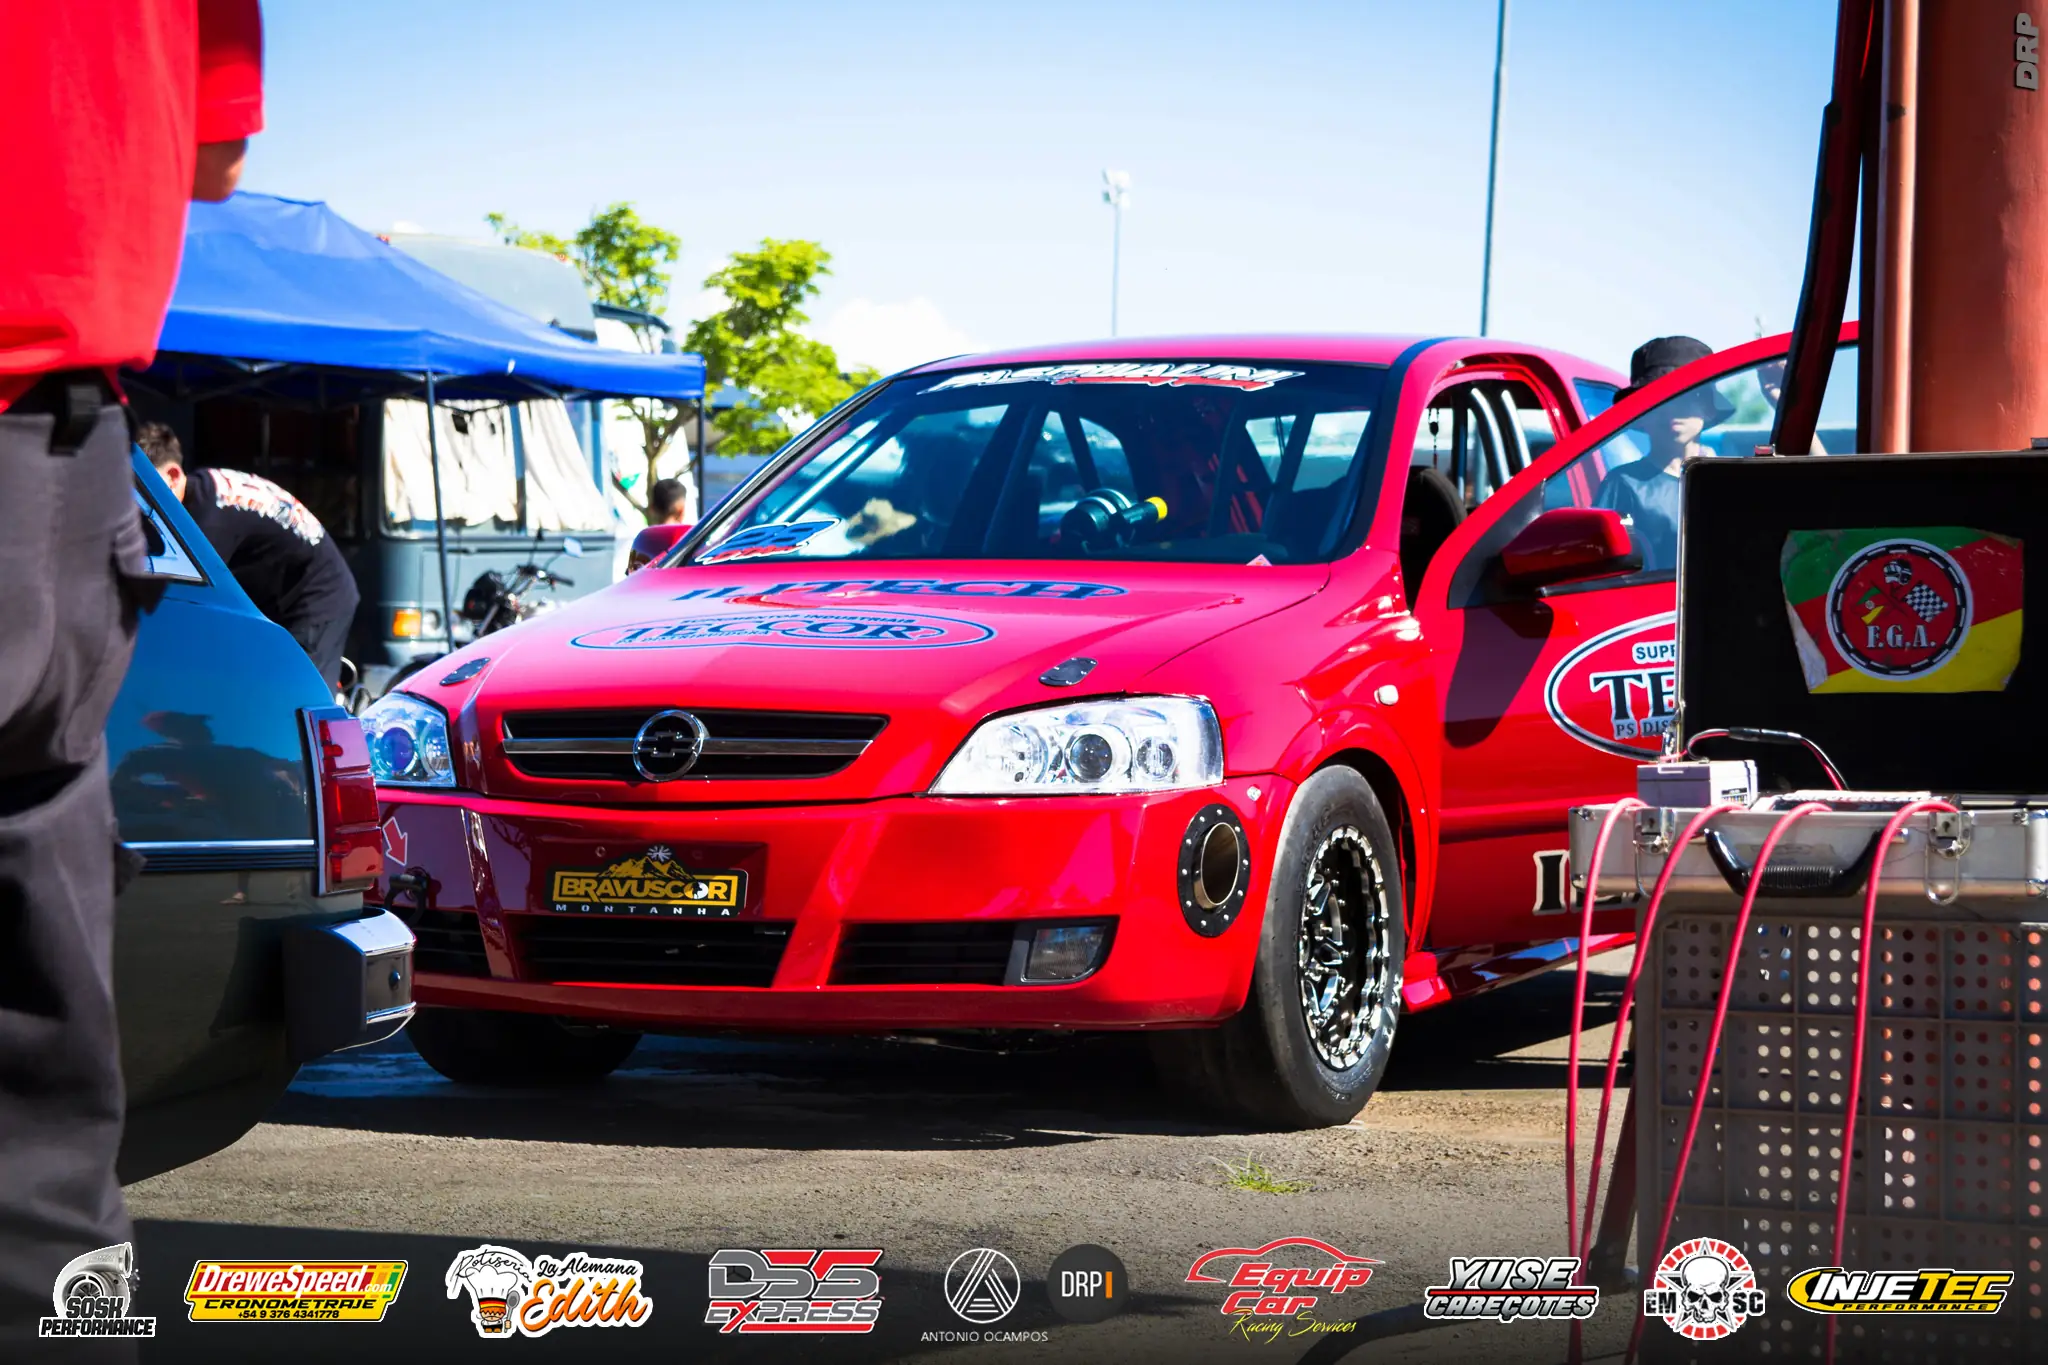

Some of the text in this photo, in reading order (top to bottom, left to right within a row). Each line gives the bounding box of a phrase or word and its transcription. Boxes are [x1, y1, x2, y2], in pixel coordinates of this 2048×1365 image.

[619, 619, 924, 640] TECCOR
[1616, 723, 1634, 736] PS
[561, 877, 728, 902] BRAVUSCOR
[555, 903, 730, 916] MONTANHA
